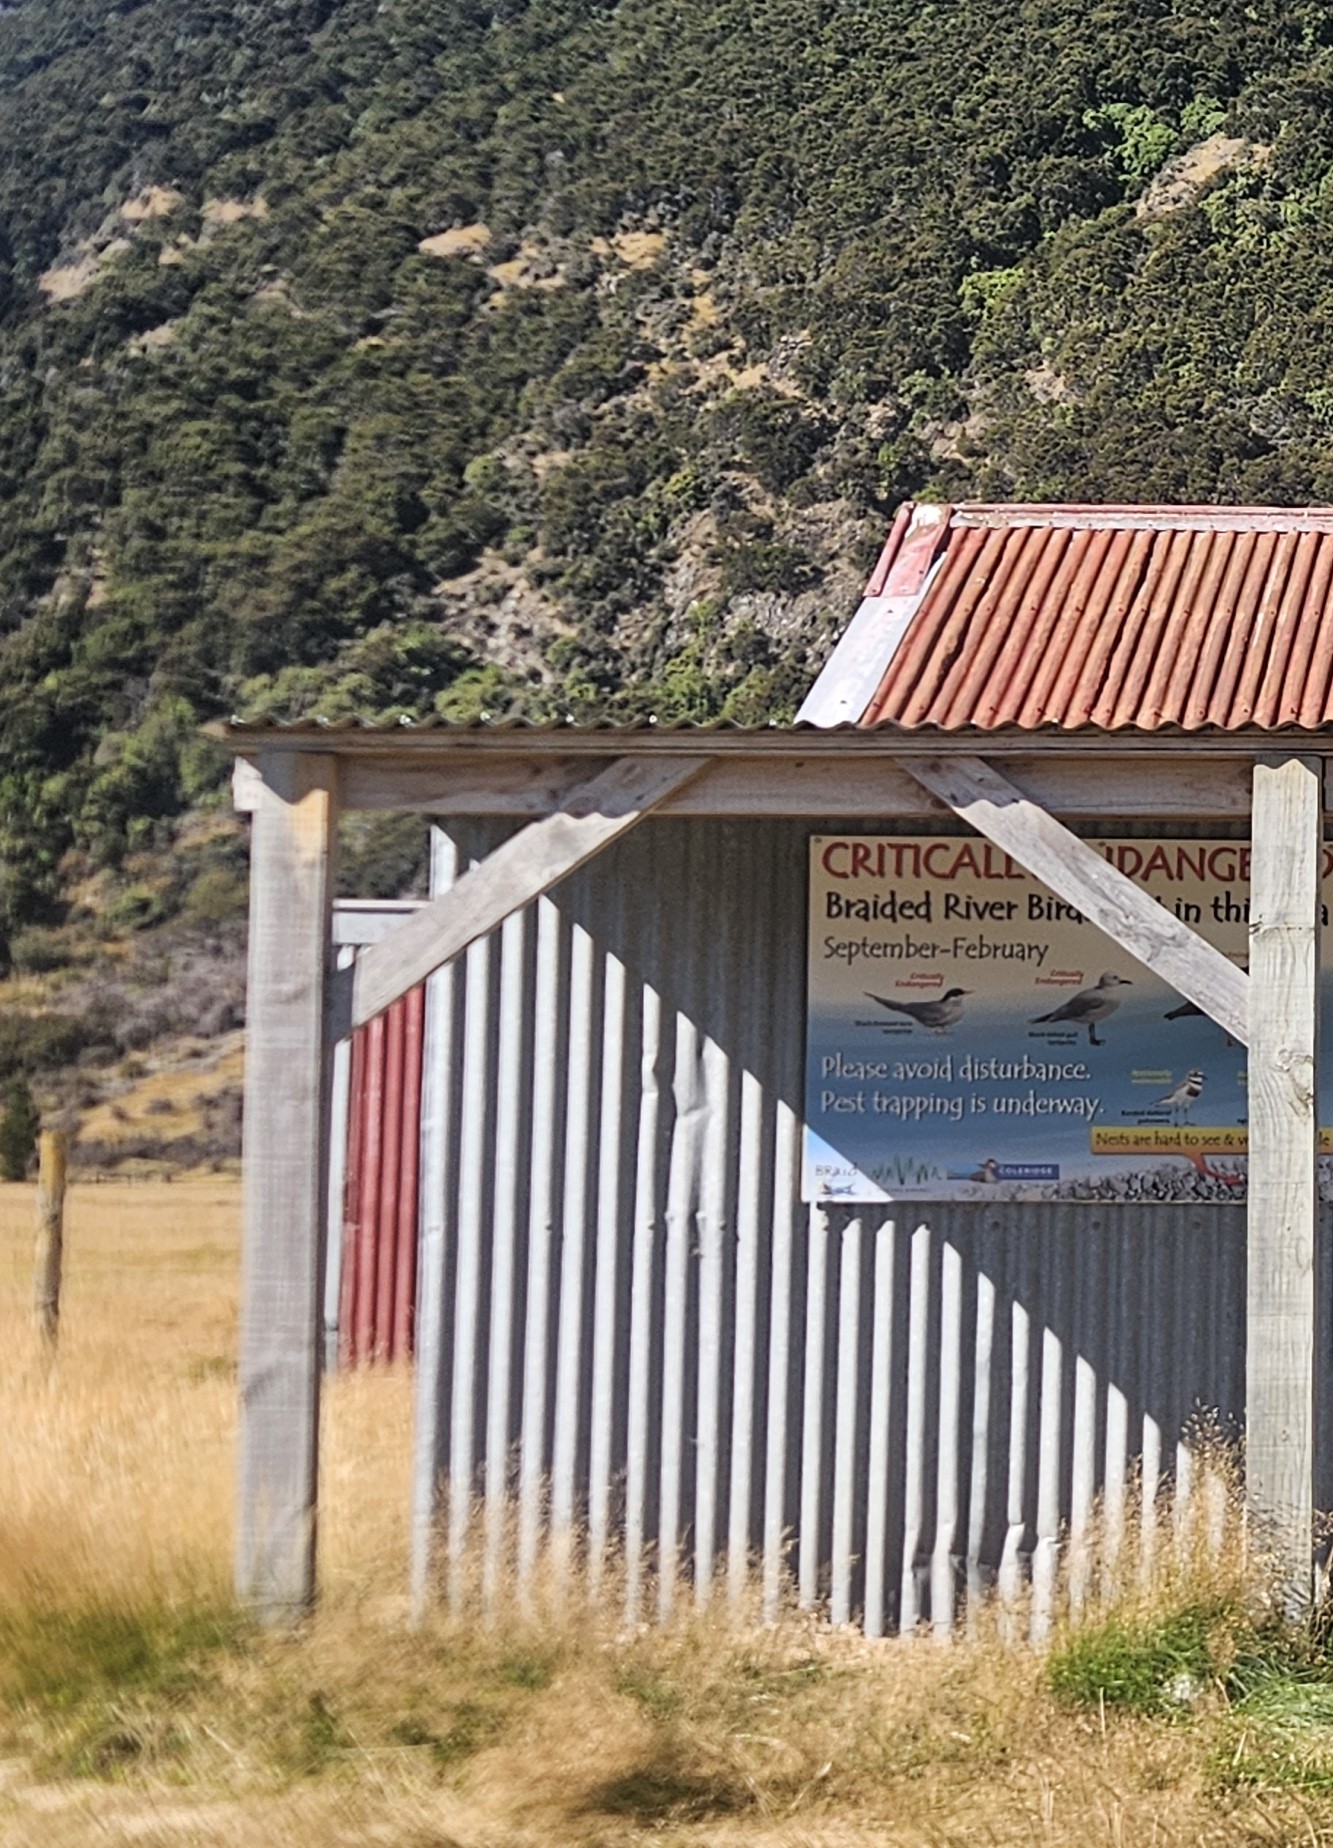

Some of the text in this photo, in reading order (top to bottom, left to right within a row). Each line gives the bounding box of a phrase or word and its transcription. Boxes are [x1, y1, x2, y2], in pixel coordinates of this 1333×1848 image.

[822, 842, 1039, 880] CRITICALL
[826, 890, 1250, 925] Braided River Bird in thi
[824, 934, 1049, 966] September-February
[821, 1053, 1092, 1081] Please avoid disturbance.
[821, 1088, 1104, 1122] Pest trapping is underway.
[1096, 1132, 1130, 1146] Nests
[1132, 1134, 1151, 1146] are
[1154, 1130, 1181, 1146] hard
[1185, 1133, 1199, 1146] to
[1202, 1135, 1220, 1146] see
